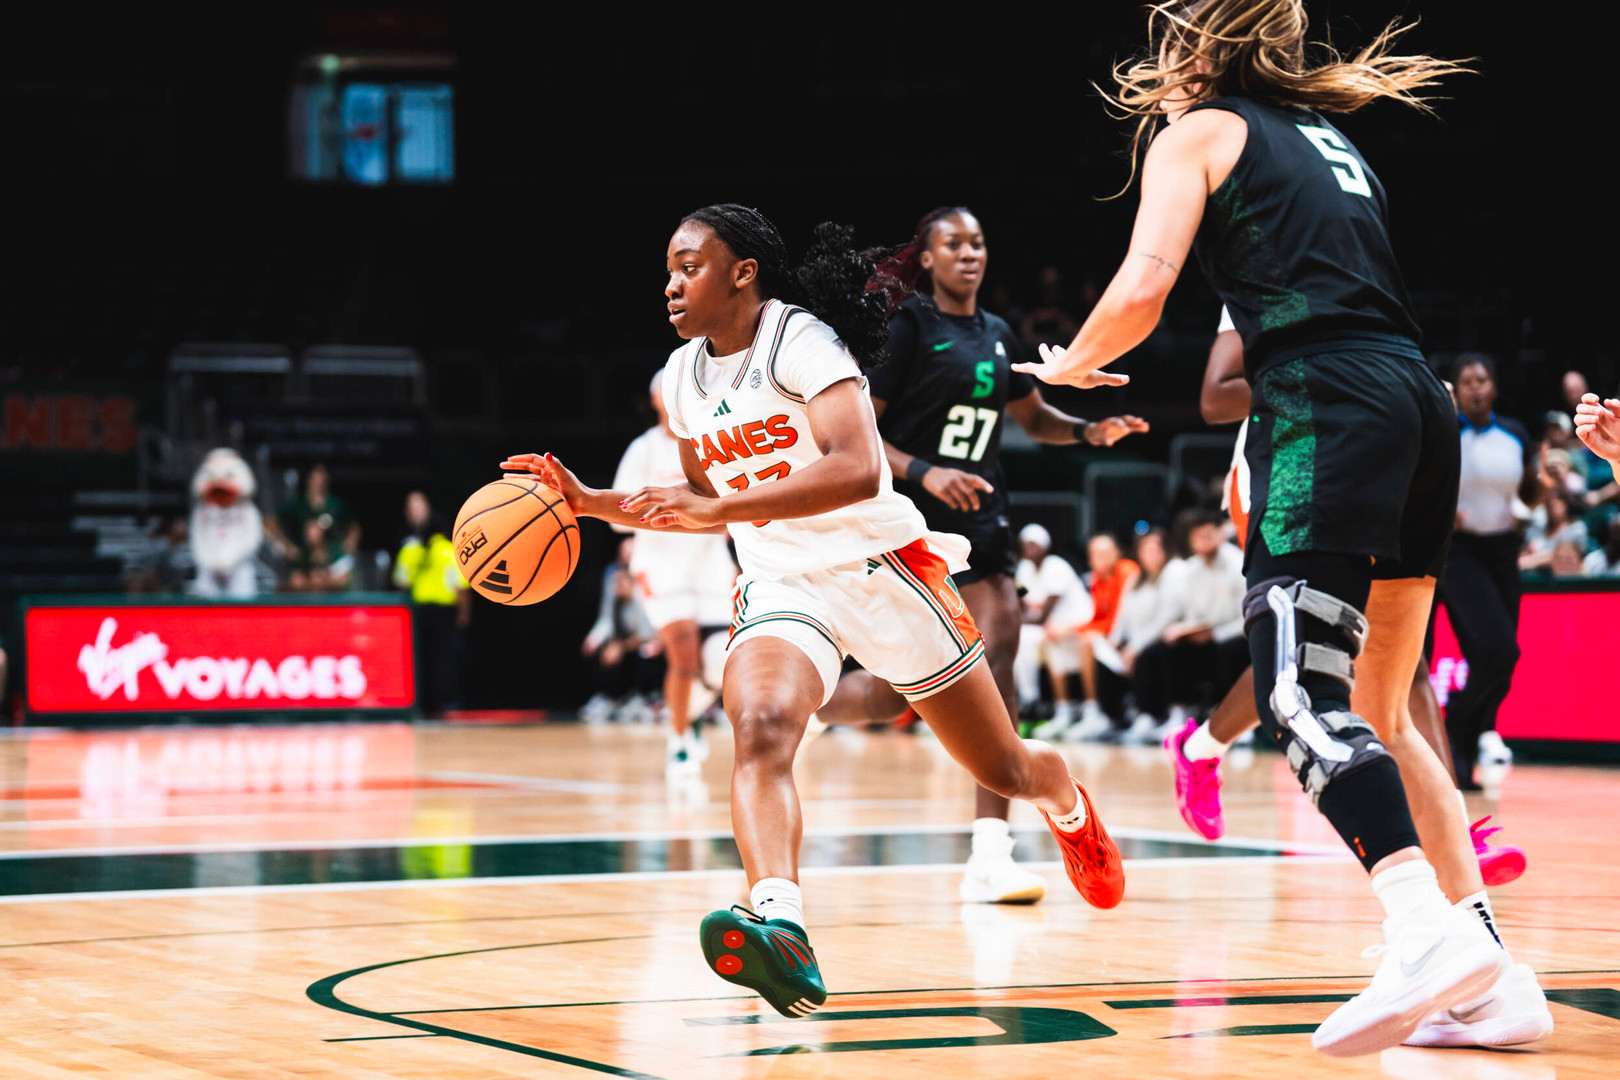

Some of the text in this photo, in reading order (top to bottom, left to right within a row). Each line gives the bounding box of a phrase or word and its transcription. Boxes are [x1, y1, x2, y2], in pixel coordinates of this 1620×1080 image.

[1295, 124, 1372, 198] 5
[971, 360, 995, 398] S
[0, 394, 138, 451] NES
[938, 404, 998, 462] 27
[459, 531, 488, 565] PRO
[153, 655, 366, 700] VOYAGES
